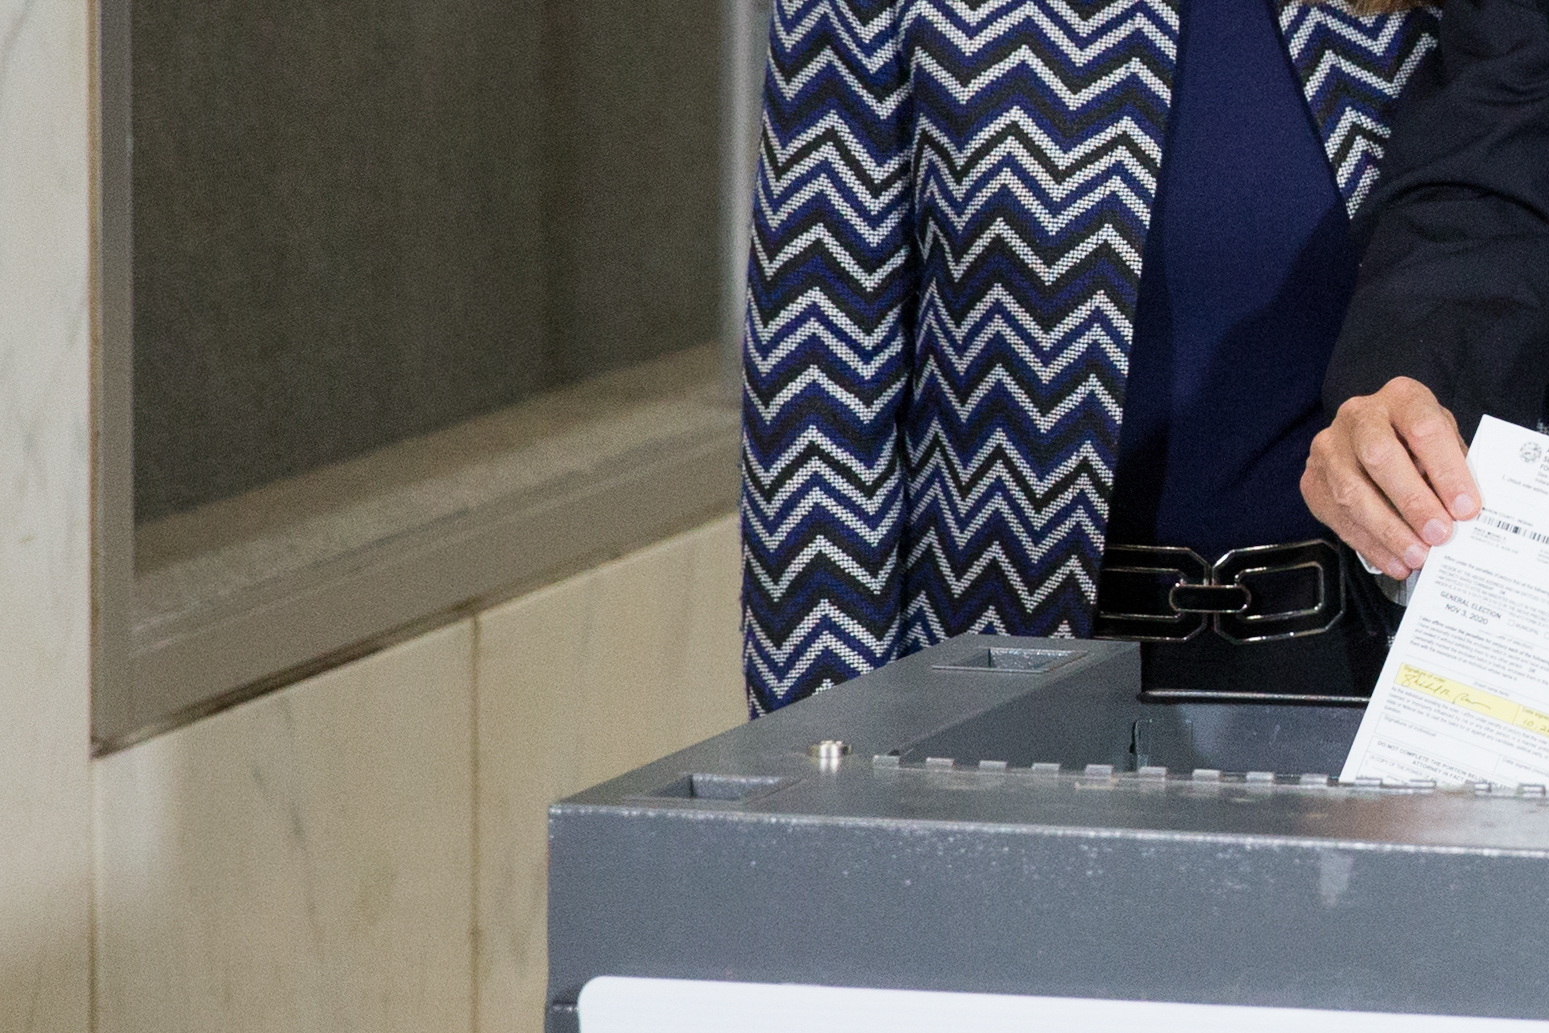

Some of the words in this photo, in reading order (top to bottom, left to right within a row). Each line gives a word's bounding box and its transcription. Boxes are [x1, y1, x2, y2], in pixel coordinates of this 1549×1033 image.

[1440, 591, 1469, 607] GENERAL
[1471, 603, 1502, 619] ELECTION
[1445, 603, 1461, 614] NOV
[1469, 613, 1489, 625] 2020
[1399, 749, 1429, 762] COMPLETE
[1431, 759, 1441, 767] THE
[1442, 763, 1467, 775] PORTION
[1412, 760, 1442, 773] ATTORNEY
